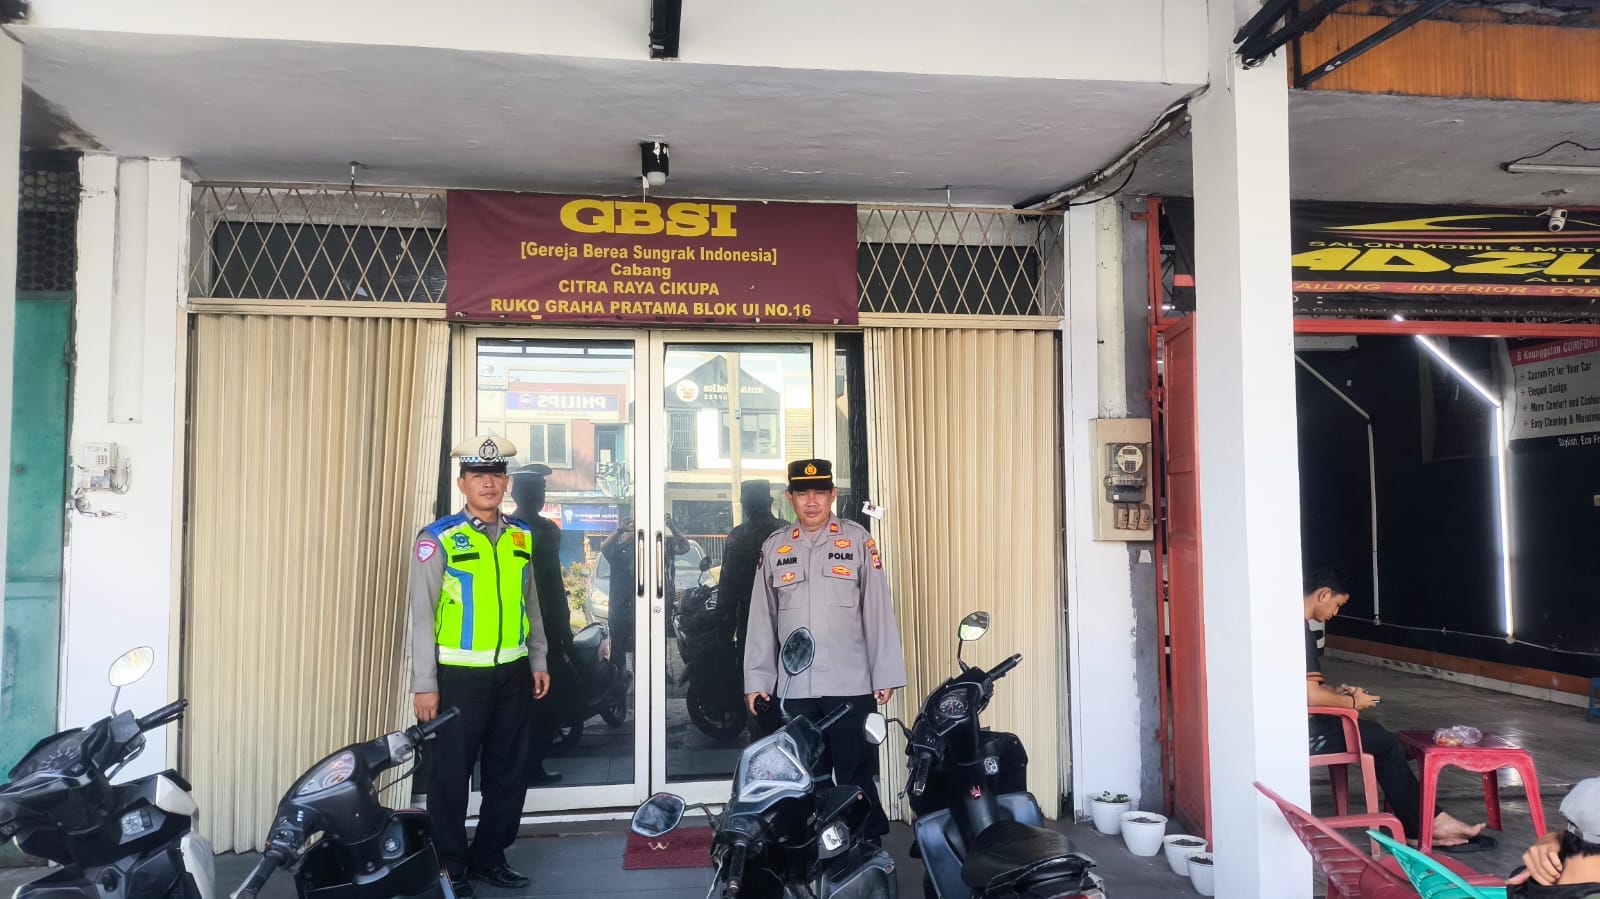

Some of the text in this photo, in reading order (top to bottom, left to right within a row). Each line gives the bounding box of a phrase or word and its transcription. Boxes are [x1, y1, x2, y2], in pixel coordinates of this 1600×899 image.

[560, 199, 737, 237] GBSI
[521, 242, 777, 265] [Gereja Berea Sungrak Indonesia]
[611, 263, 671, 280] Cabang
[558, 280, 720, 296] CITRA RAYA CIKUPA
[1411, 284, 1528, 293] INTERIOR
[491, 298, 540, 312] RUKO
[546, 300, 604, 314] GRAHA
[610, 301, 688, 314] PRATAMA
[693, 302, 738, 316] BLOK
[765, 304, 812, 316] NO.16
[1567, 363, 1579, 374] Your
[1581, 362, 1592, 372] Car
[1549, 383, 1568, 394] Design
[1531, 402, 1544, 412] More
[1546, 399, 1567, 410] Comfort
[1531, 419, 1543, 429] Easy
[776, 557, 798, 566] AMIR
